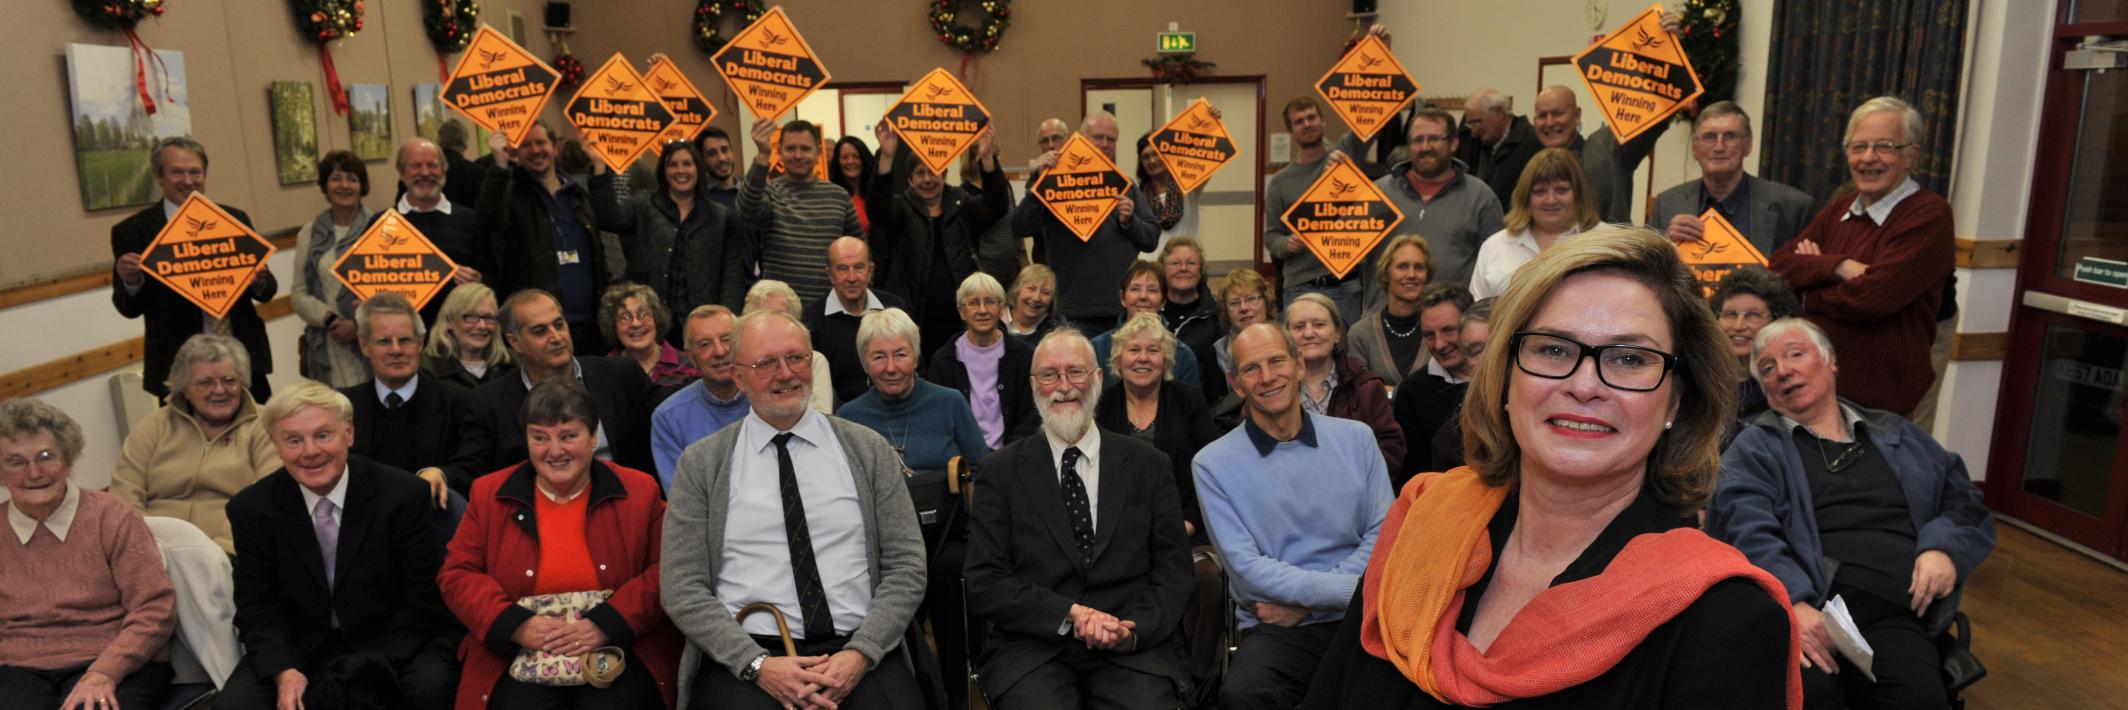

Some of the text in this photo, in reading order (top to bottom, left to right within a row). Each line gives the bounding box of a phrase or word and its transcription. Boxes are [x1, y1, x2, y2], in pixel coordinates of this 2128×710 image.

[743, 50, 797, 70] Liberal
[1610, 52, 1670, 80] Liberal
[469, 68, 526, 90] Liberal
[726, 62, 812, 87] Democrats
[1344, 74, 1392, 87] Liberal
[1587, 64, 1682, 99] Democrats
[456, 82, 545, 107] Democrats
[749, 84, 788, 101] Winning
[1329, 86, 1405, 100] Democrats
[590, 100, 644, 115] Liberal
[756, 99, 776, 112] Here
[1611, 91, 1656, 112] Winning
[486, 105, 526, 119] Winning
[913, 104, 964, 118] Liberal
[1350, 104, 1384, 115] Winning
[1616, 108, 1642, 122] Here
[498, 120, 520, 130] Here
[576, 112, 660, 130] Democrats
[898, 116, 978, 132] Democrats
[1356, 116, 1376, 124] Here
[598, 133, 638, 145] Winning
[920, 135, 956, 146] Winning
[1174, 132, 1216, 148] Liberal
[607, 146, 628, 155] Here
[928, 148, 948, 158] Here
[1160, 141, 1226, 160] Democrats
[1177, 159, 1206, 172] Winning
[1056, 172, 1104, 187] Liberal
[1181, 170, 1197, 180] Here
[1045, 186, 1118, 200] Democrats
[1066, 204, 1099, 214] Winning
[1314, 202, 1368, 216] Liberal
[1074, 216, 1092, 224] Here
[1298, 218, 1384, 230] Democrats
[172, 238, 236, 258] Liberal
[1321, 236, 1360, 248] Winning
[364, 254, 422, 269] Liberal
[1330, 250, 1351, 259] Here
[157, 252, 256, 275] Democrats
[348, 269, 440, 283] Democrats
[2094, 266, 2104, 274] bar
[2104, 268, 2112, 276] to
[189, 274, 234, 288] Winning
[202, 289, 227, 300] Here
